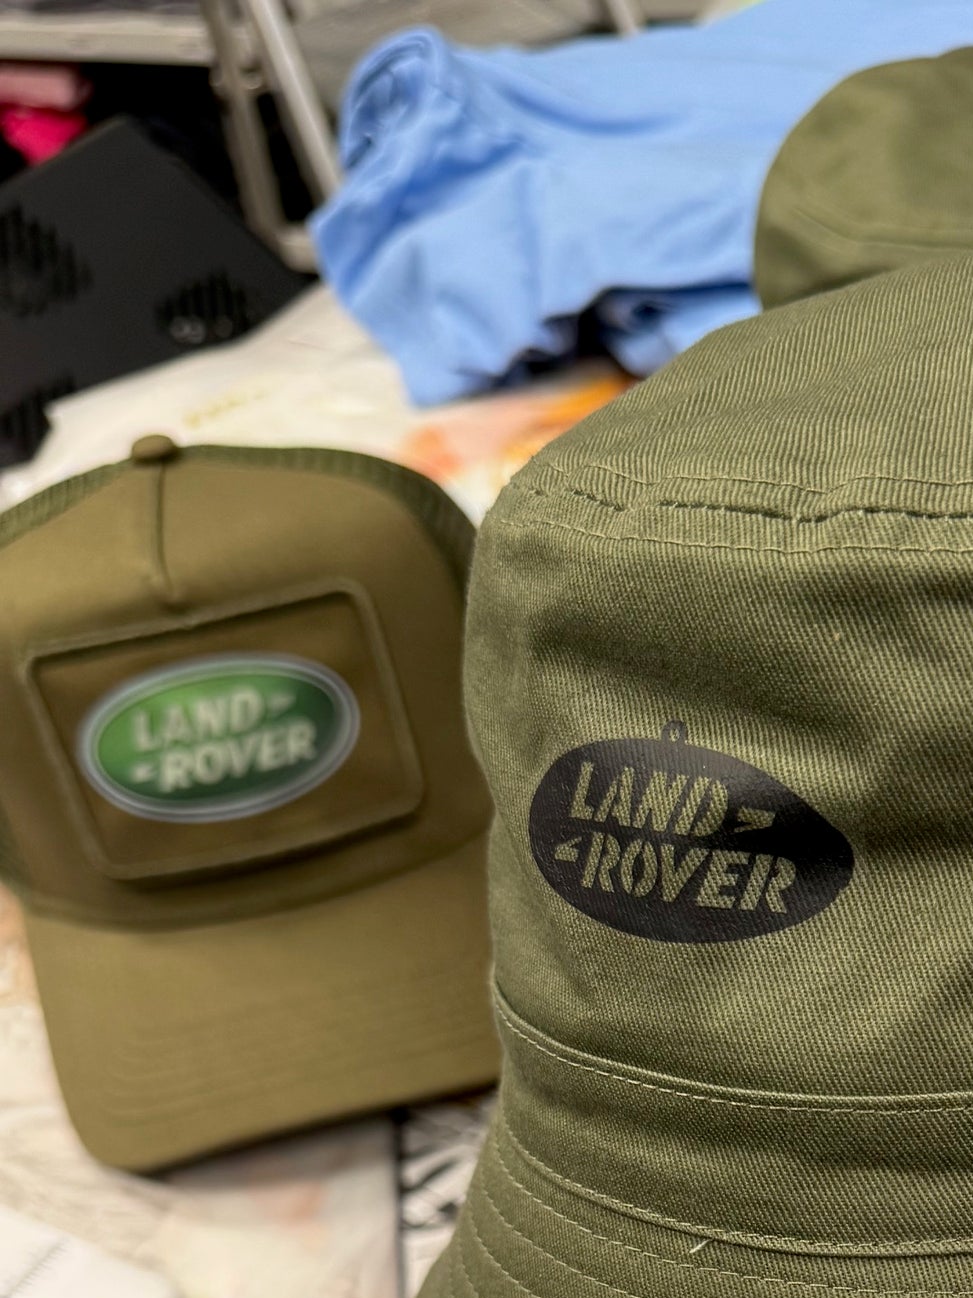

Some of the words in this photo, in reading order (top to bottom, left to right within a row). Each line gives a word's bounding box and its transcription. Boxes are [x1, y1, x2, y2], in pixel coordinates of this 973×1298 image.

[132, 687, 264, 751] LAND
[159, 716, 319, 794] ROVER
[568, 760, 730, 838] LAND
[580, 831, 798, 915] ROVER
